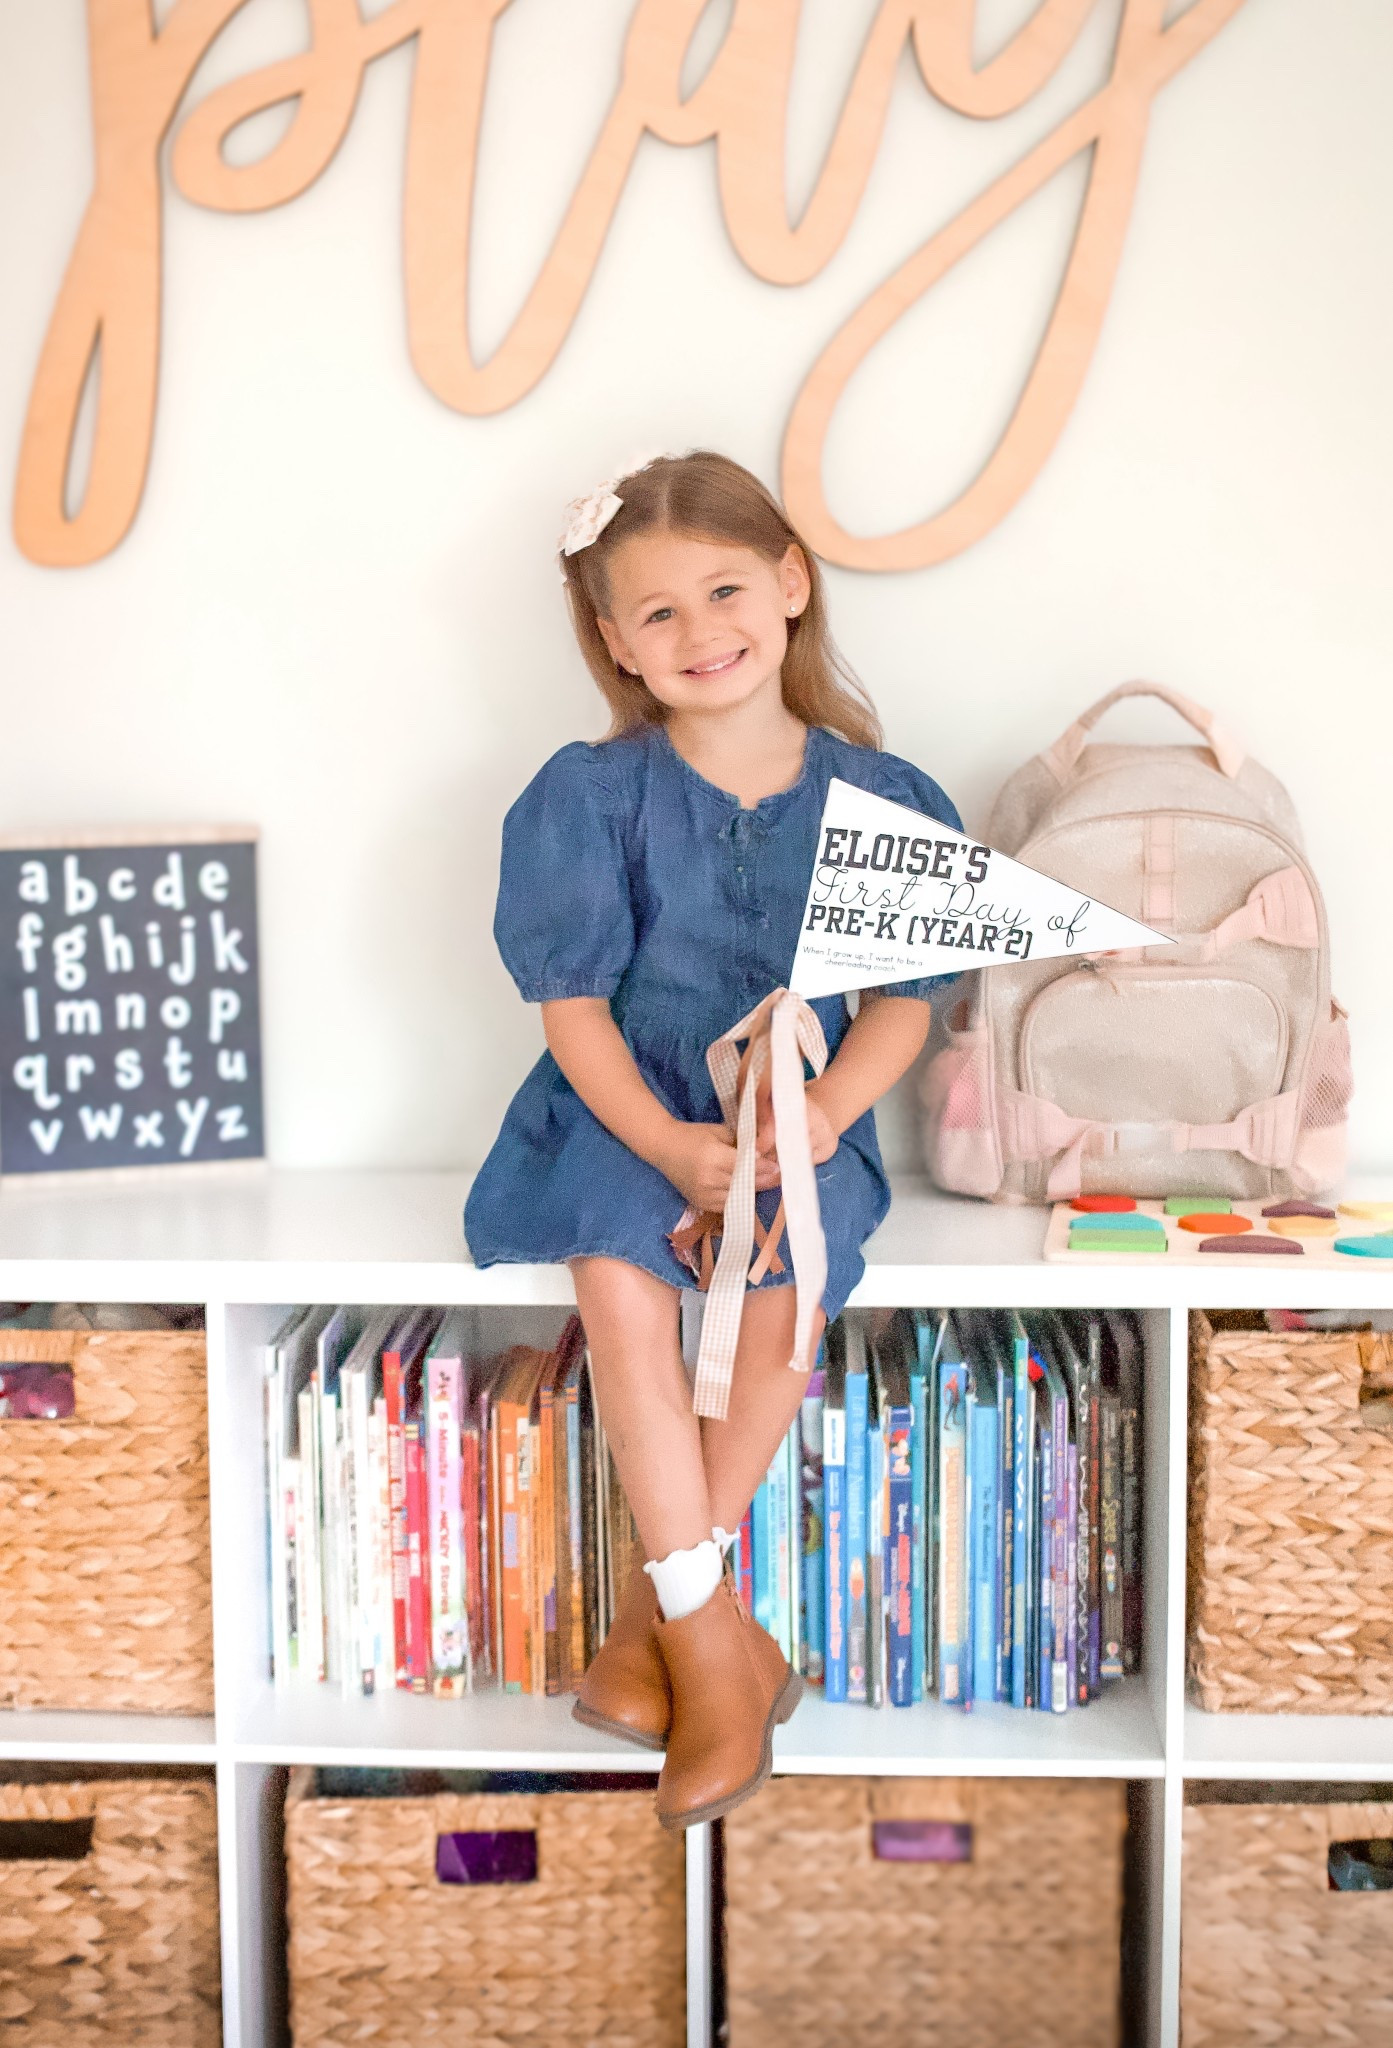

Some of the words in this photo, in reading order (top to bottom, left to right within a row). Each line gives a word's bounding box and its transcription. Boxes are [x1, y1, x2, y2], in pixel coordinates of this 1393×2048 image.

[819, 827, 992, 884] ELOISE'S
[805, 904, 898, 940] PRE-K
[813, 865, 923, 911] First
[933, 881, 1031, 940] Day
[1047, 900, 1091, 947] of
[803, 946, 824, 956] When
[833, 950, 852, 959] grow
[875, 955, 894, 963] want
[824, 958, 872, 970] cheerleading
